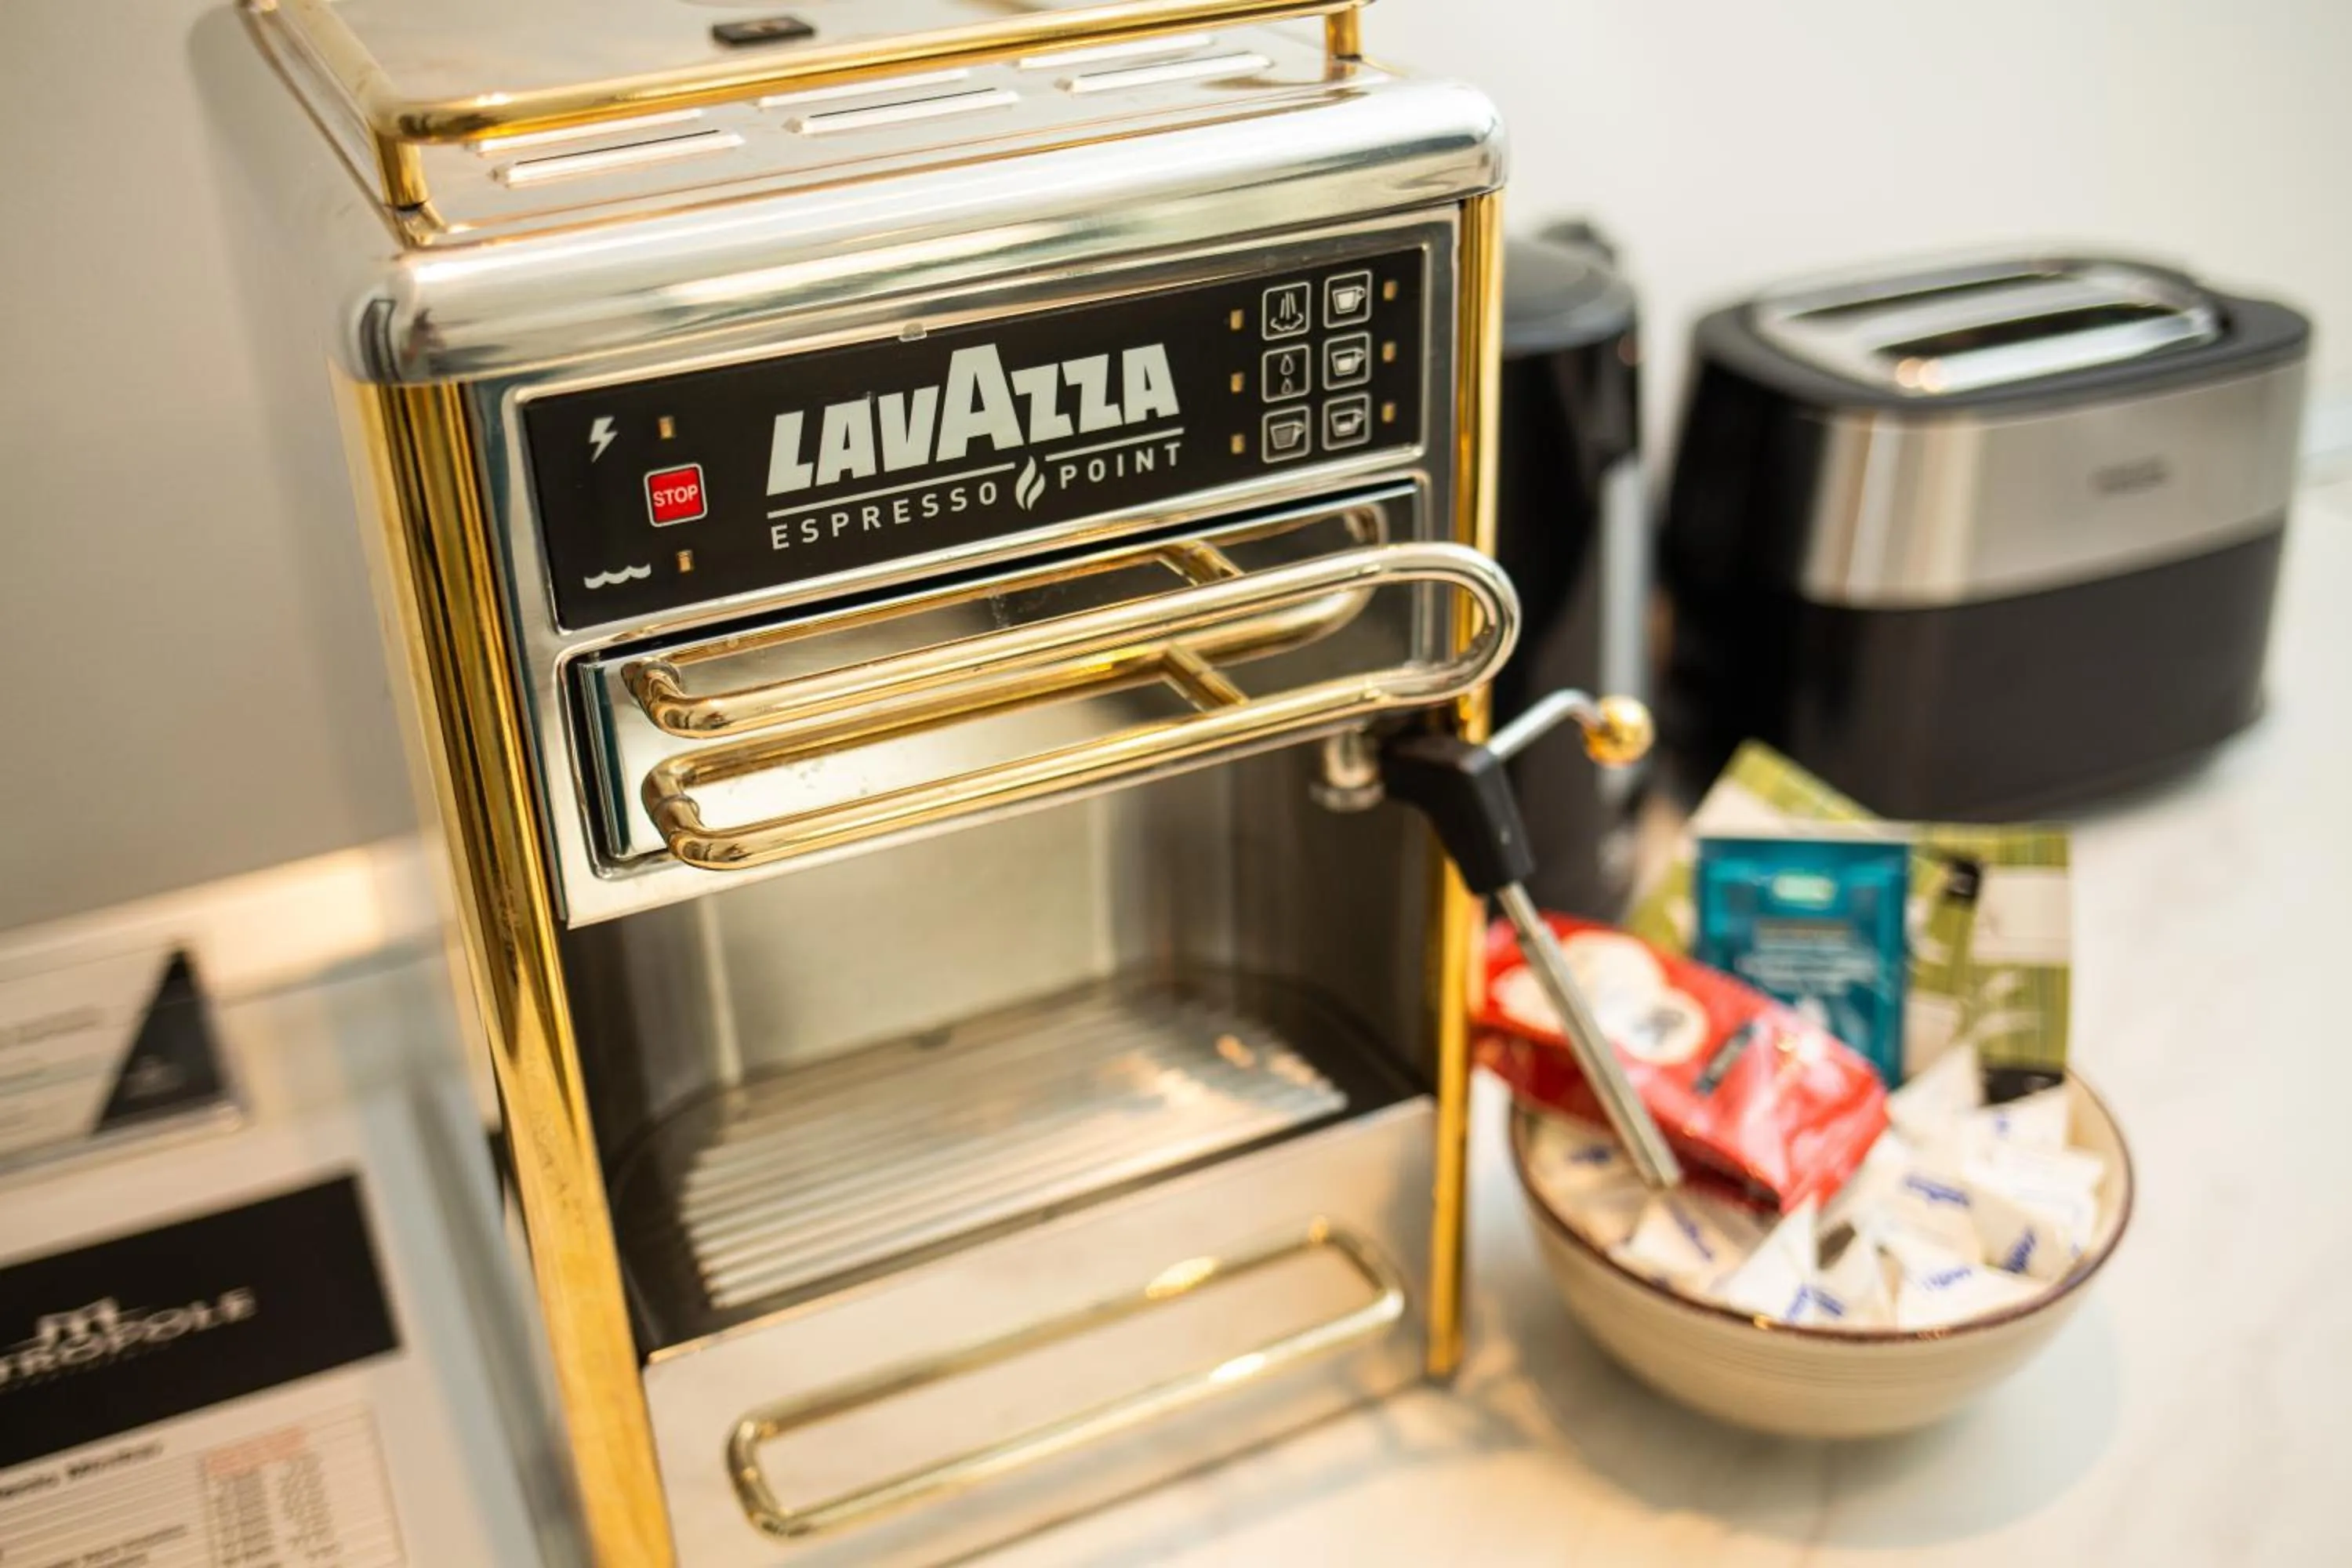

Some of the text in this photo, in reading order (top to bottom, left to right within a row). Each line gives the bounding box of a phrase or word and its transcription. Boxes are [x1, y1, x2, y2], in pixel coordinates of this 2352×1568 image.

[766, 343, 1180, 496] LAVAZZA
[653, 484, 699, 507] STOP
[771, 442, 1181, 550] ESPRESSO POINT
